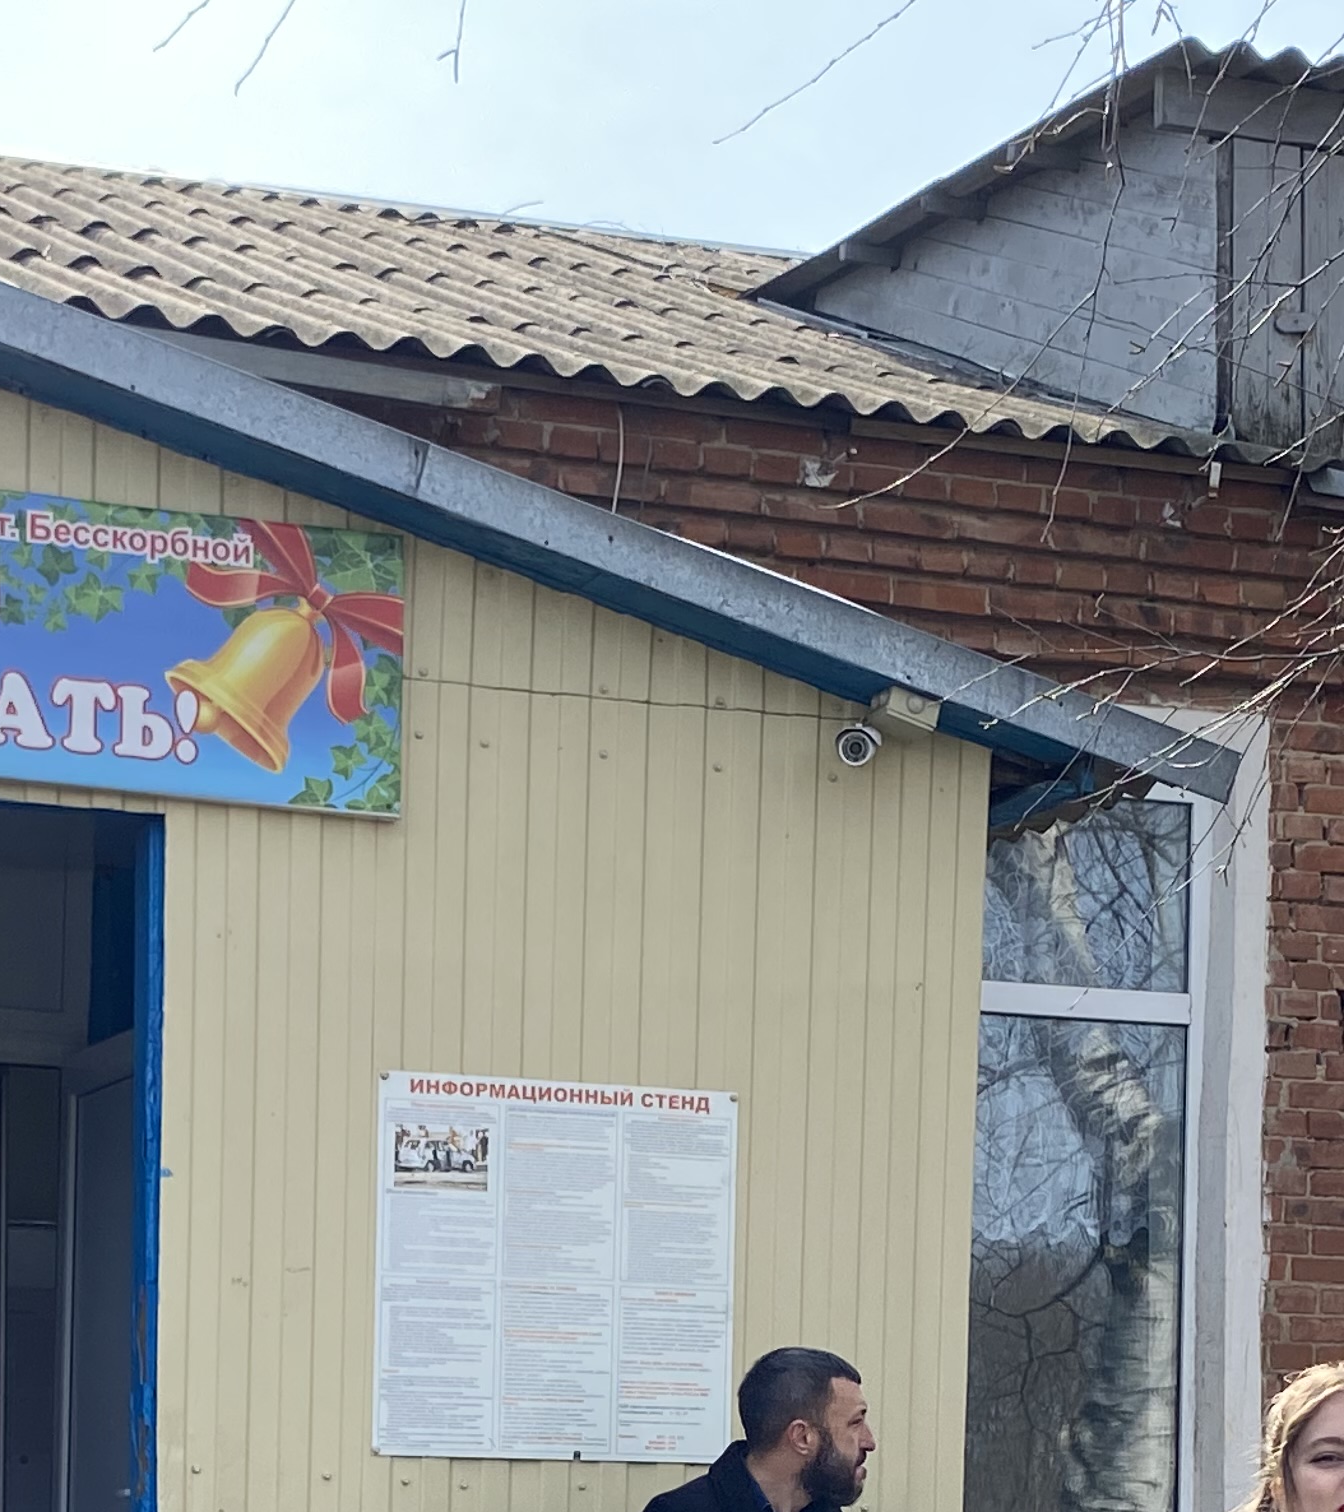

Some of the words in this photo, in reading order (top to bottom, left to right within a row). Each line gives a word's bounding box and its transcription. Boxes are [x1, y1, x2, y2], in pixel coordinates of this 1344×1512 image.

[27, 511, 254, 565] Бесскорбной
[410, 1078, 633, 1107] ИНФОРМАЦИОННЫЙ
[641, 1094, 710, 1114] СТЕНД
